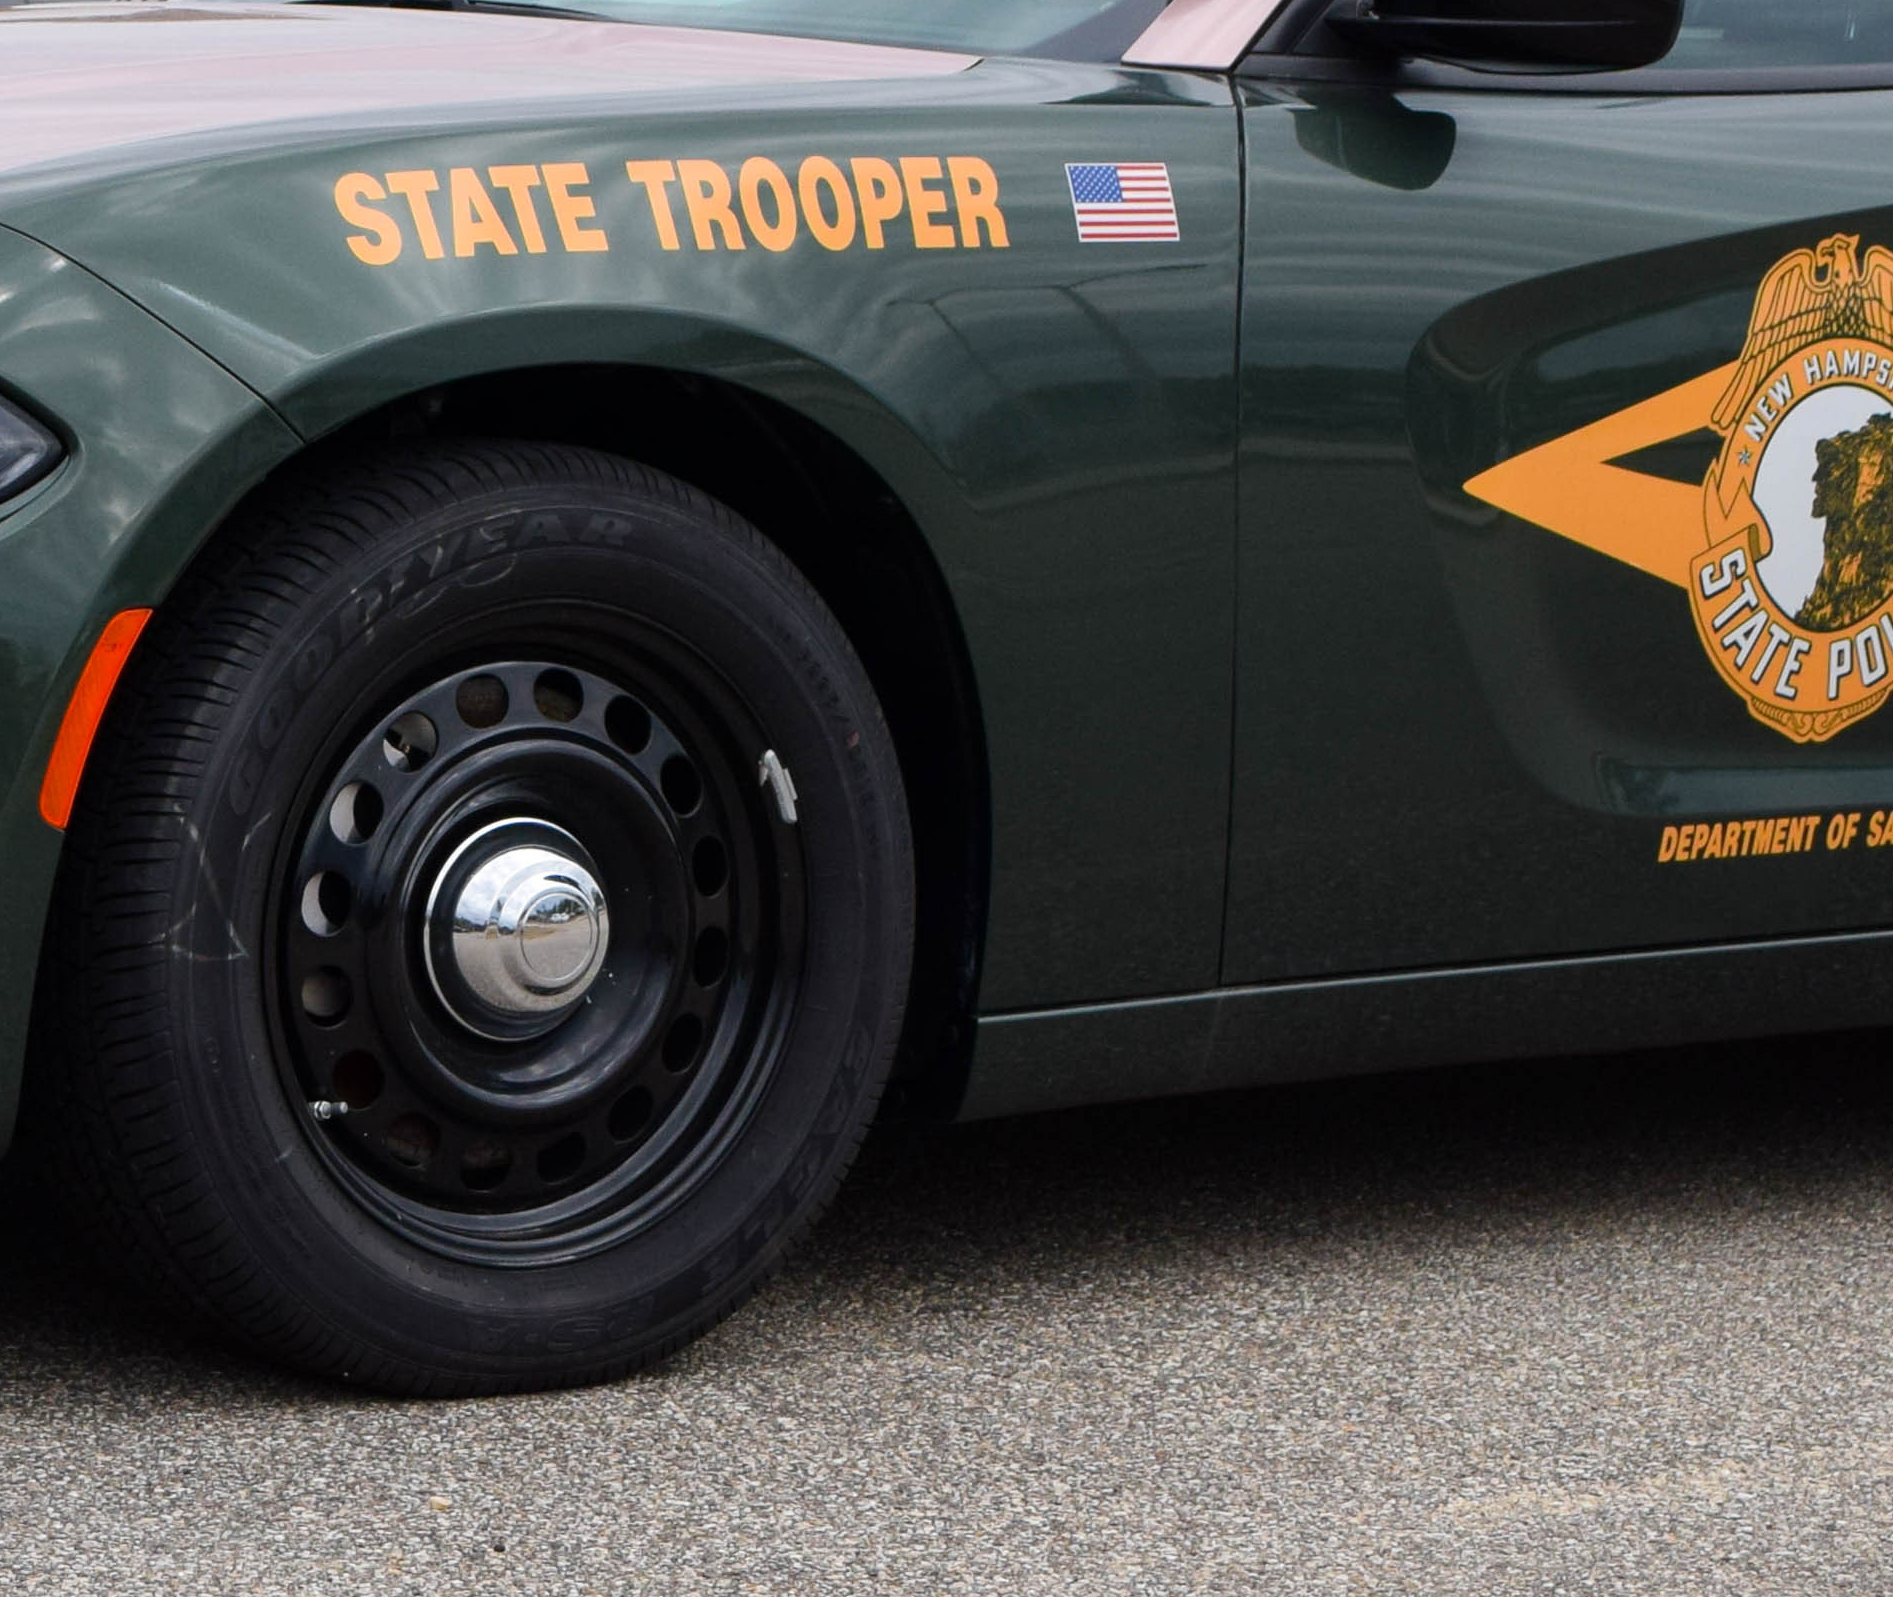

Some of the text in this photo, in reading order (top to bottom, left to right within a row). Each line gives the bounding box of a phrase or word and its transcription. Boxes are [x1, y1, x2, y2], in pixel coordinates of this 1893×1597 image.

[334, 155, 1010, 267] STATE TROOPER
[1744, 380, 1795, 441] NEW
[1700, 548, 1812, 700] STATE
[1657, 815, 1820, 863] DEPARTMENT
[1826, 812, 1860, 850] OF
